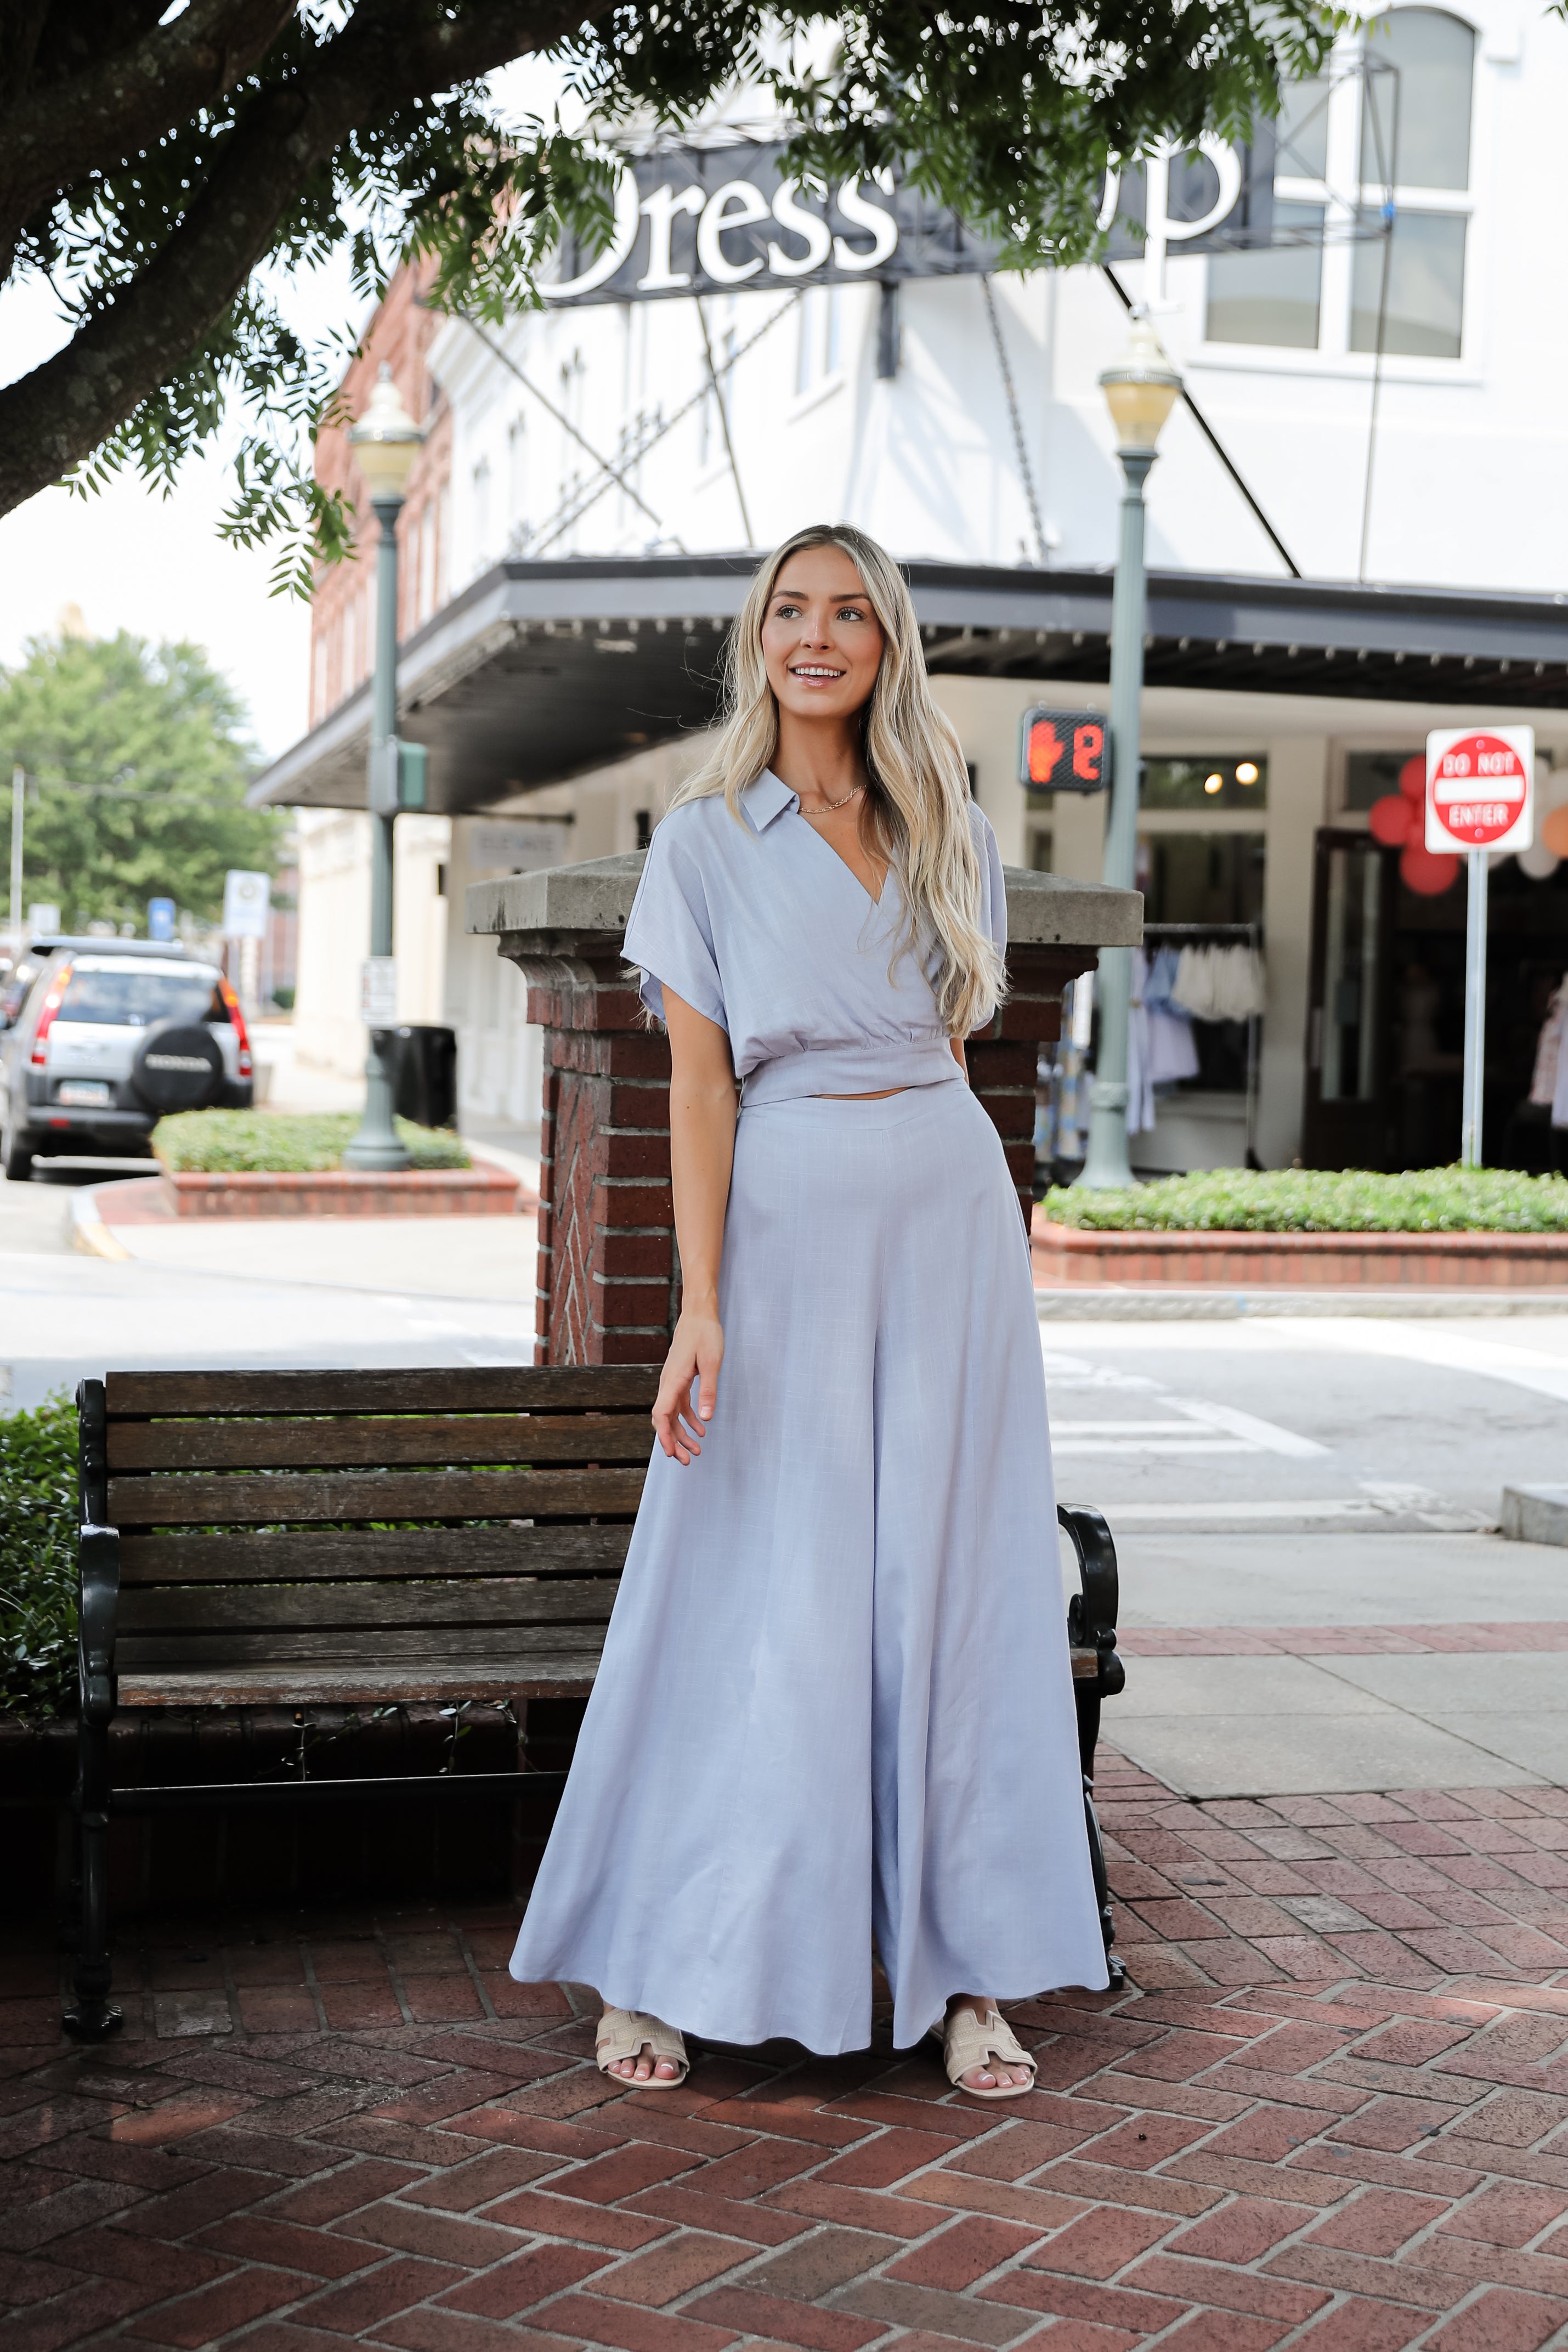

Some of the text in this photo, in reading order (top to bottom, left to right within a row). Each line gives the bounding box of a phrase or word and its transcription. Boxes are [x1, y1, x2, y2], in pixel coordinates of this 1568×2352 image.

[1442, 751, 1515, 777] DO NOT
[1449, 804, 1509, 828] ENTER
